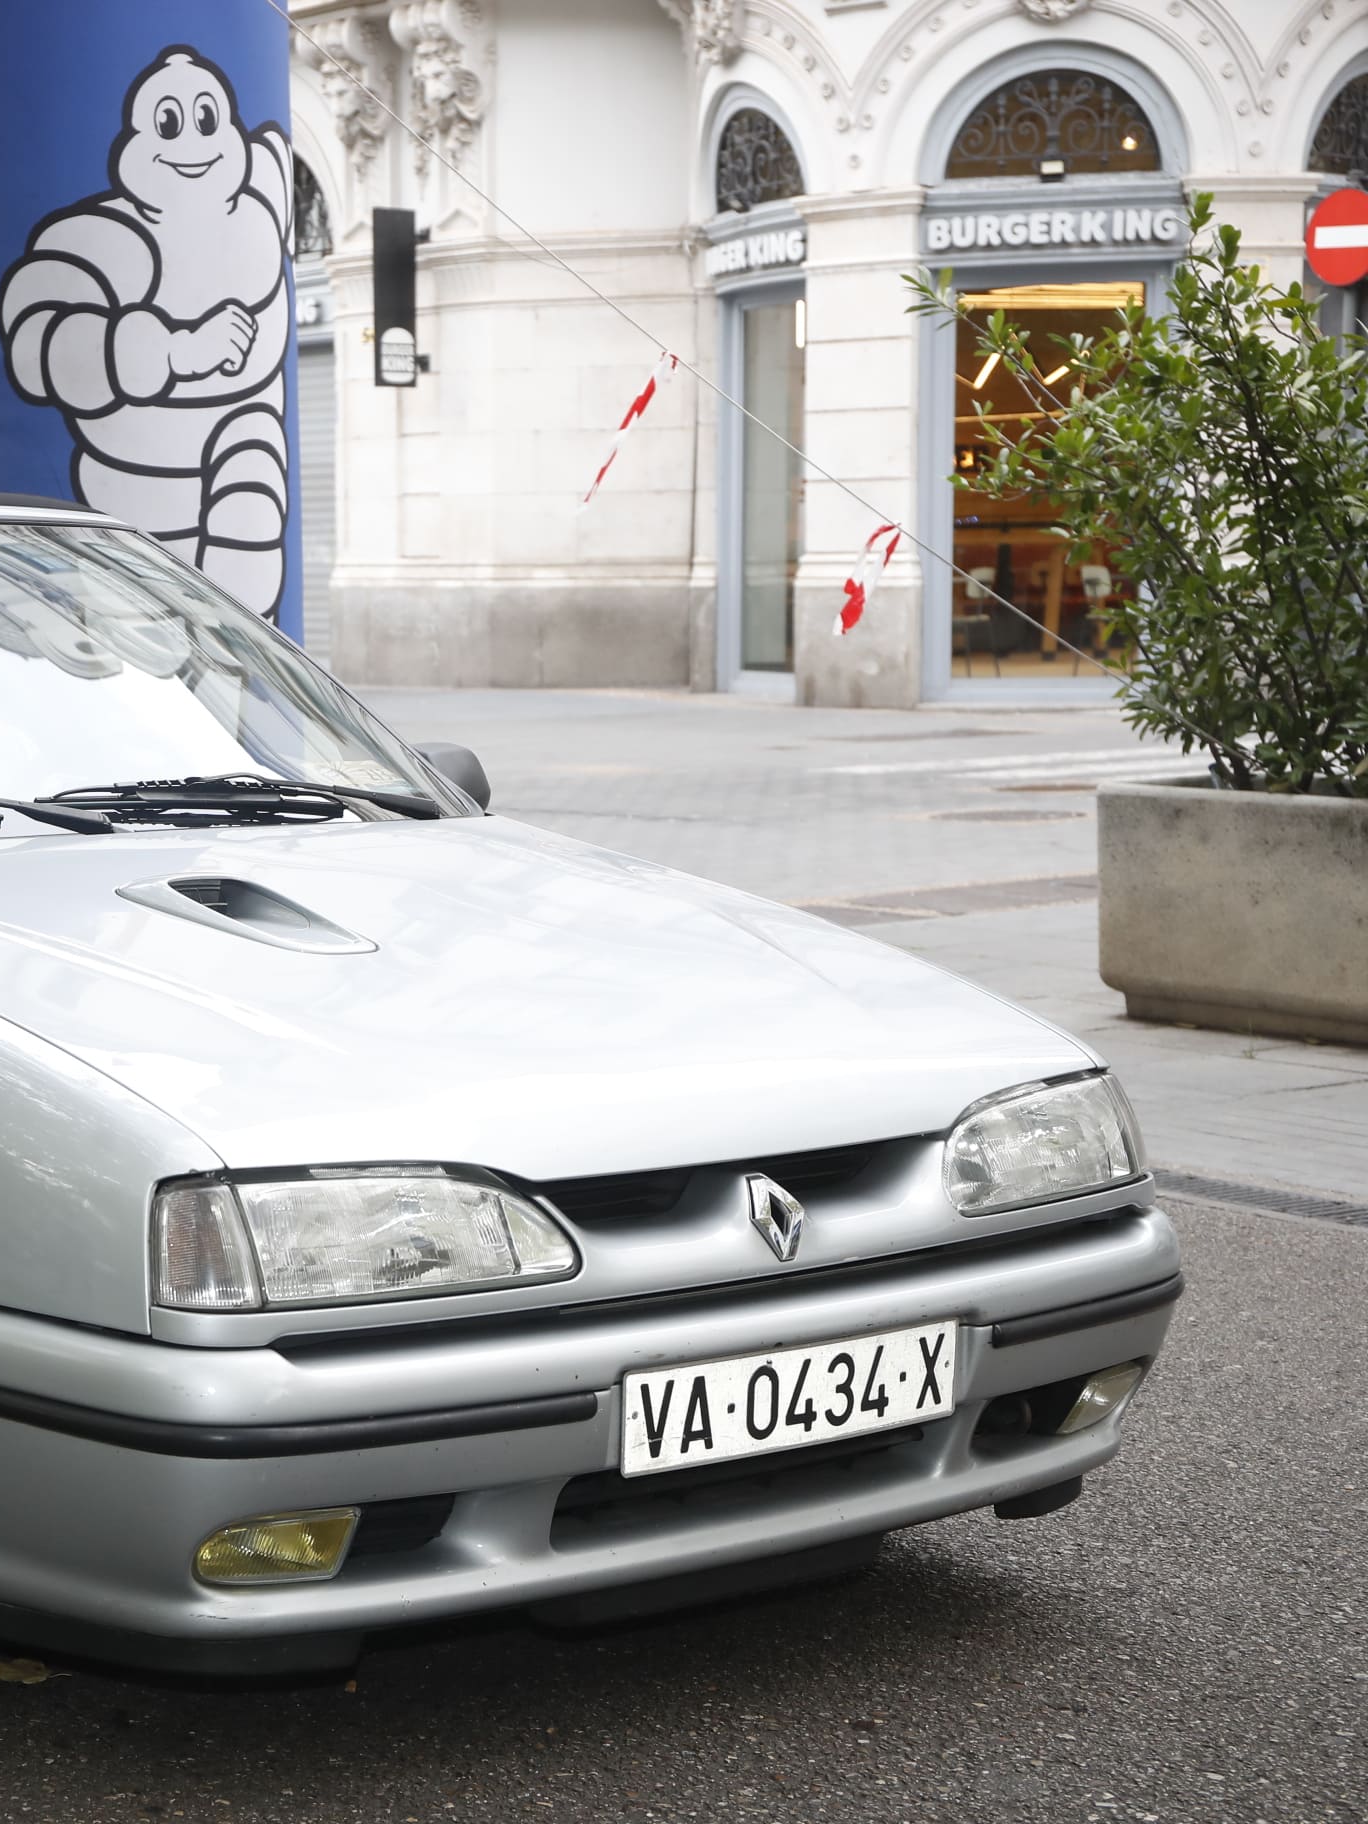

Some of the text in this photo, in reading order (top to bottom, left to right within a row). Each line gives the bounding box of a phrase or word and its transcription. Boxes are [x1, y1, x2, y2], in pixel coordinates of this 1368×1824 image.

[748, 230, 804, 265] KING
[927, 209, 1179, 249] BURGER KING
